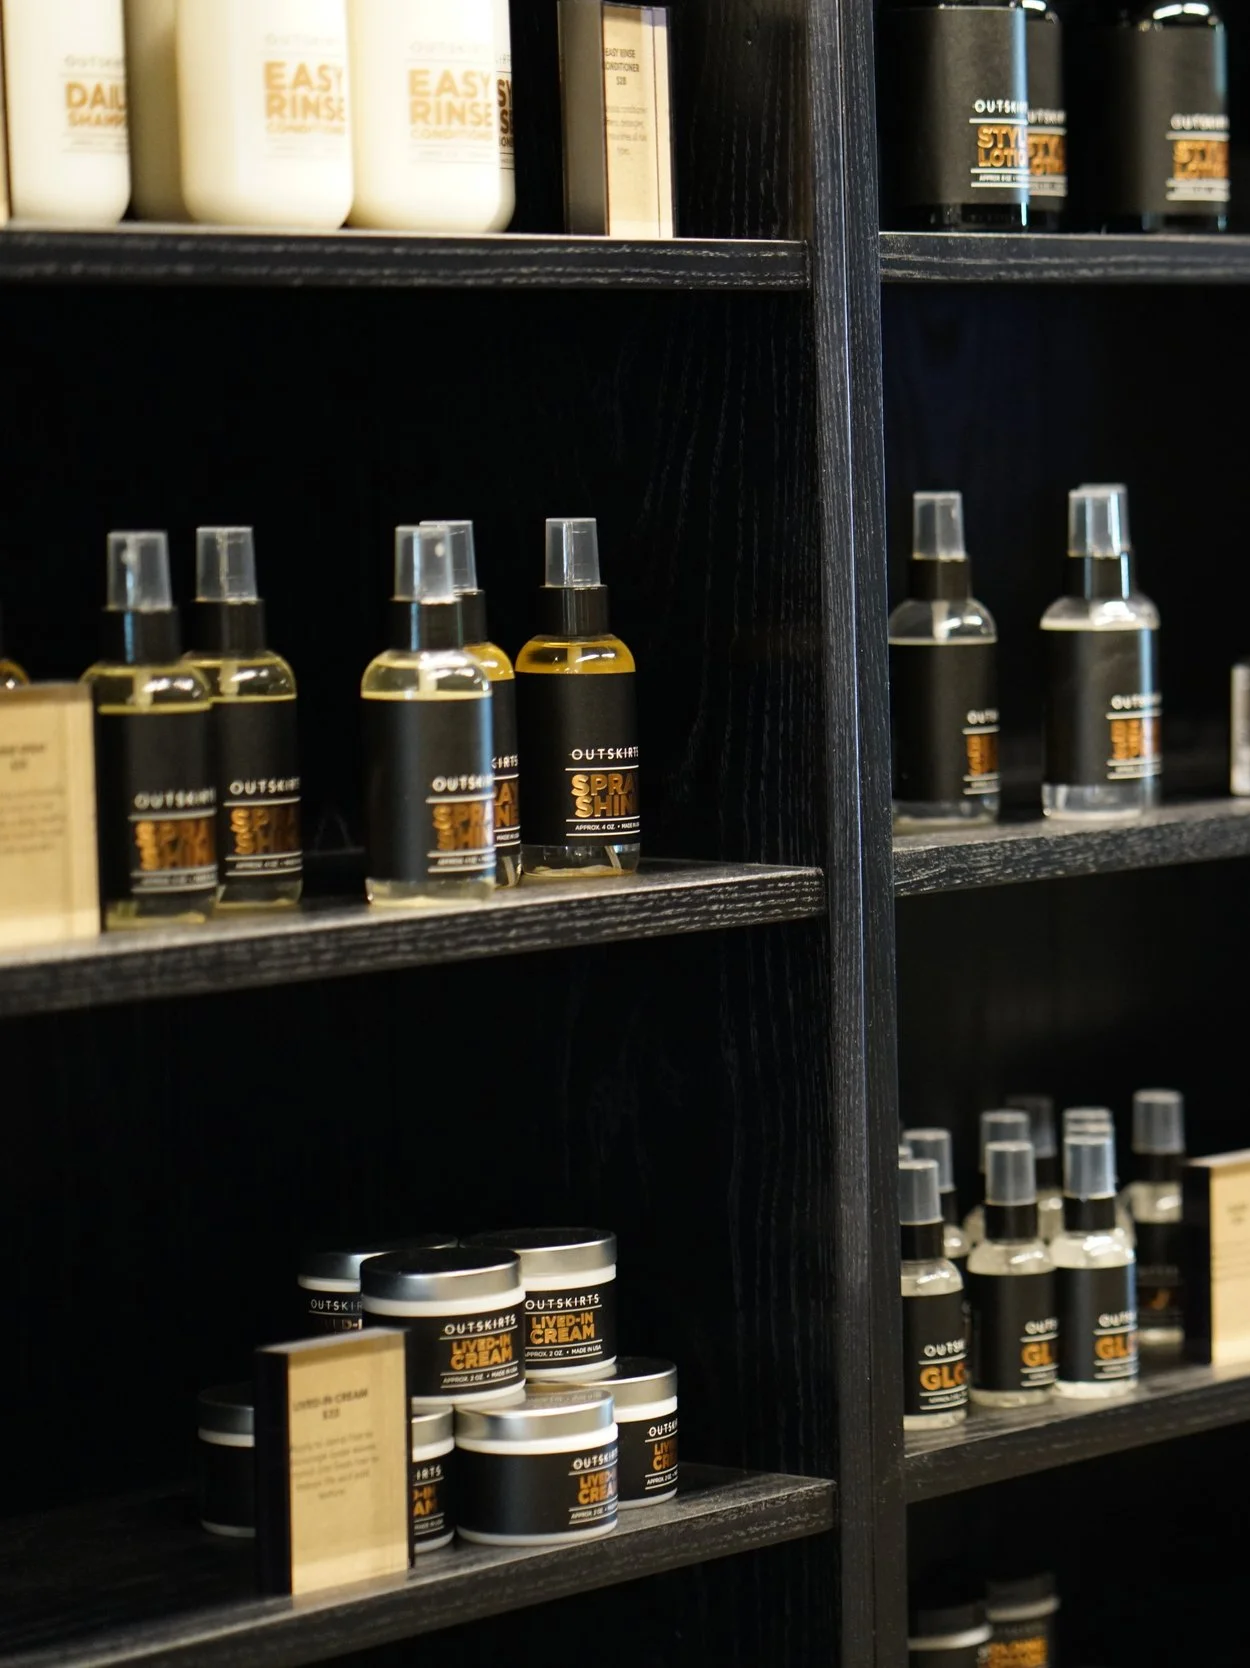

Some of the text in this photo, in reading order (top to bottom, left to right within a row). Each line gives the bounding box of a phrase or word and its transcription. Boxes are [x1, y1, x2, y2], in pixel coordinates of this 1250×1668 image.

[263, 60, 343, 92] EASY
[408, 69, 491, 99] EASY
[264, 94, 345, 122] RINSE
[410, 100, 493, 127] RINSE
[525, 1293, 599, 1310] OUTSKIRTS
[444, 1314, 516, 1336] OUTSKIRTS
[531, 1311, 594, 1330] LIVED-IN
[452, 1332, 511, 1355] LIVED-IN
[530, 1324, 595, 1345] CREAM
[450, 1346, 513, 1371] CREAM
[571, 1347, 587, 1355] MADE
